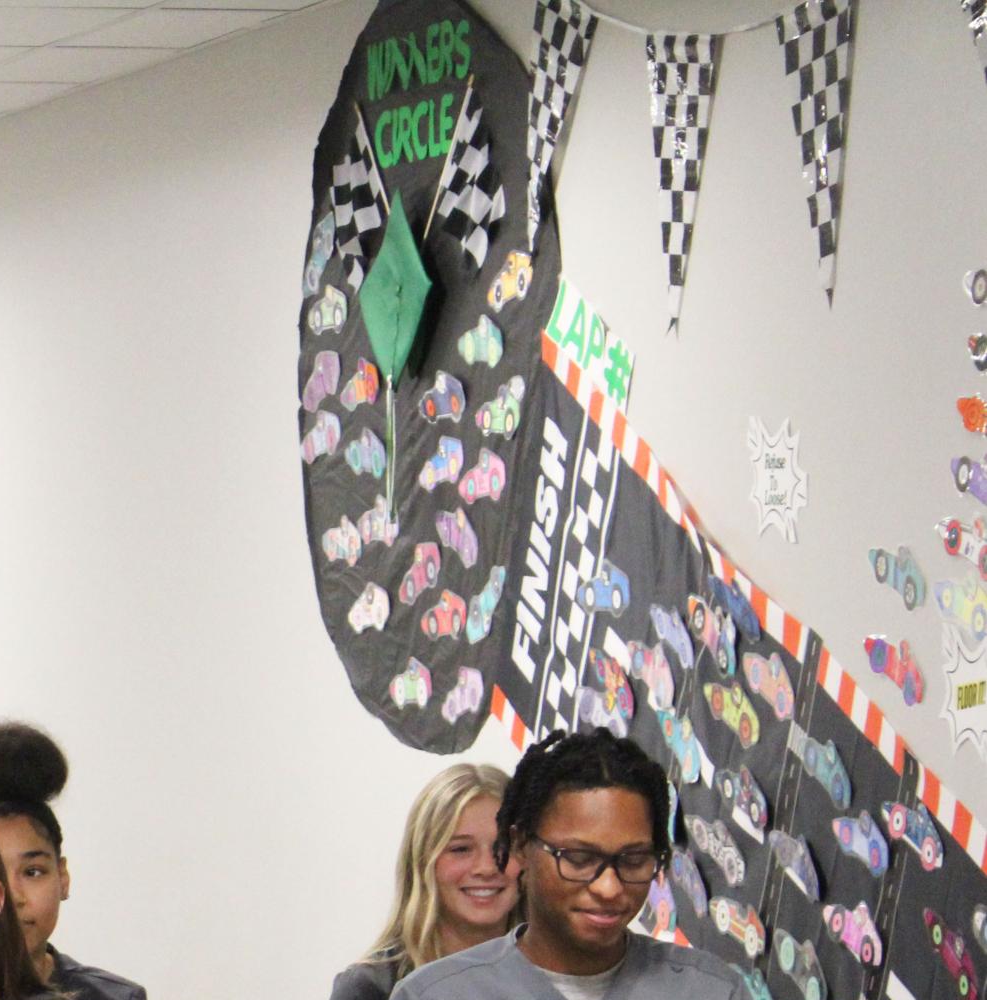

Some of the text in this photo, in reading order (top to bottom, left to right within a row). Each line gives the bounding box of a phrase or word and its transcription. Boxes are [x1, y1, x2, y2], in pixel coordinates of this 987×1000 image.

[373, 93, 455, 168] CIRCLE
[547, 280, 606, 370] LAP
[511, 416, 569, 685] FINISH
